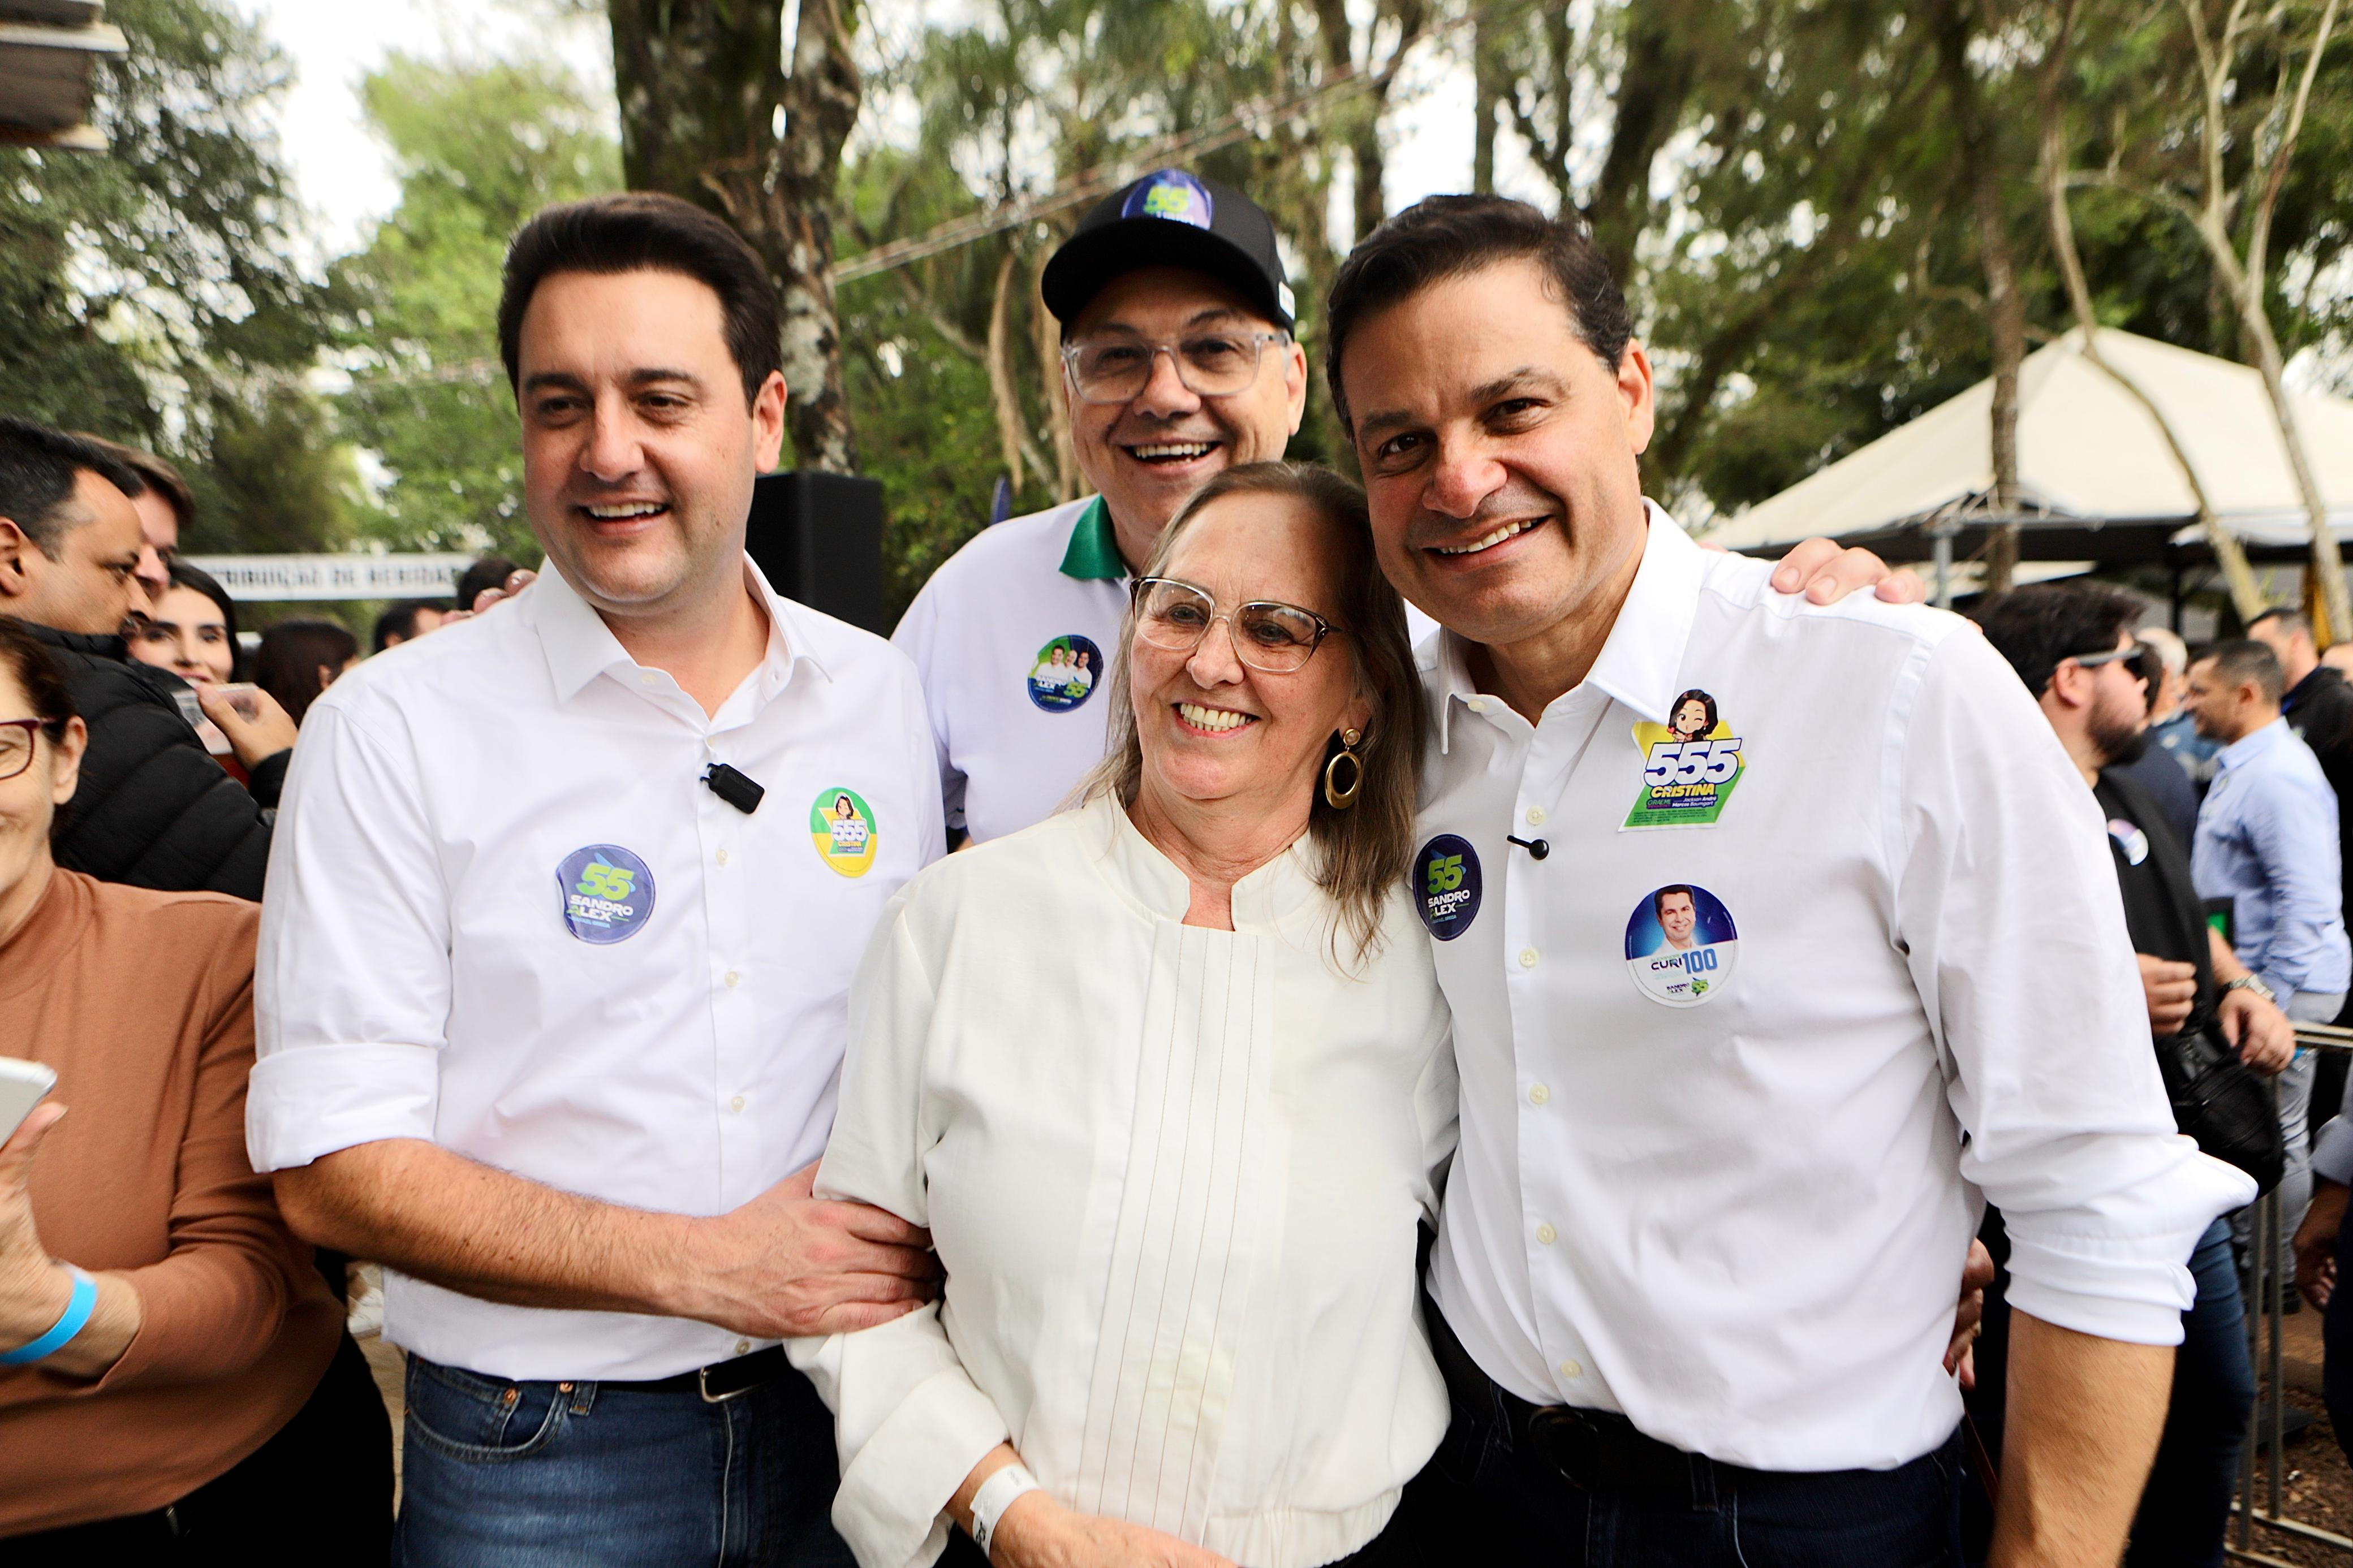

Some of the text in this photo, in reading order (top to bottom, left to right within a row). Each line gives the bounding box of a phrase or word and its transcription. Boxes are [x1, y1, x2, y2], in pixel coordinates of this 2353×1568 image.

[1143, 185, 1190, 214] 55
[1063, 681, 1088, 698] 55
[1644, 738, 1742, 787] 555
[1650, 783, 1716, 798] CRISTINA
[833, 819, 867, 841] 555
[575, 862, 635, 901] 55
[1427, 854, 1463, 895] 55
[570, 894, 634, 917] SANDRO
[1428, 889, 1470, 908] SANDRO
[567, 905, 613, 922] ALEX
[1430, 902, 1456, 919] ALEX
[1651, 948, 1718, 974] CURI 100
[1691, 979, 1709, 994] 55
